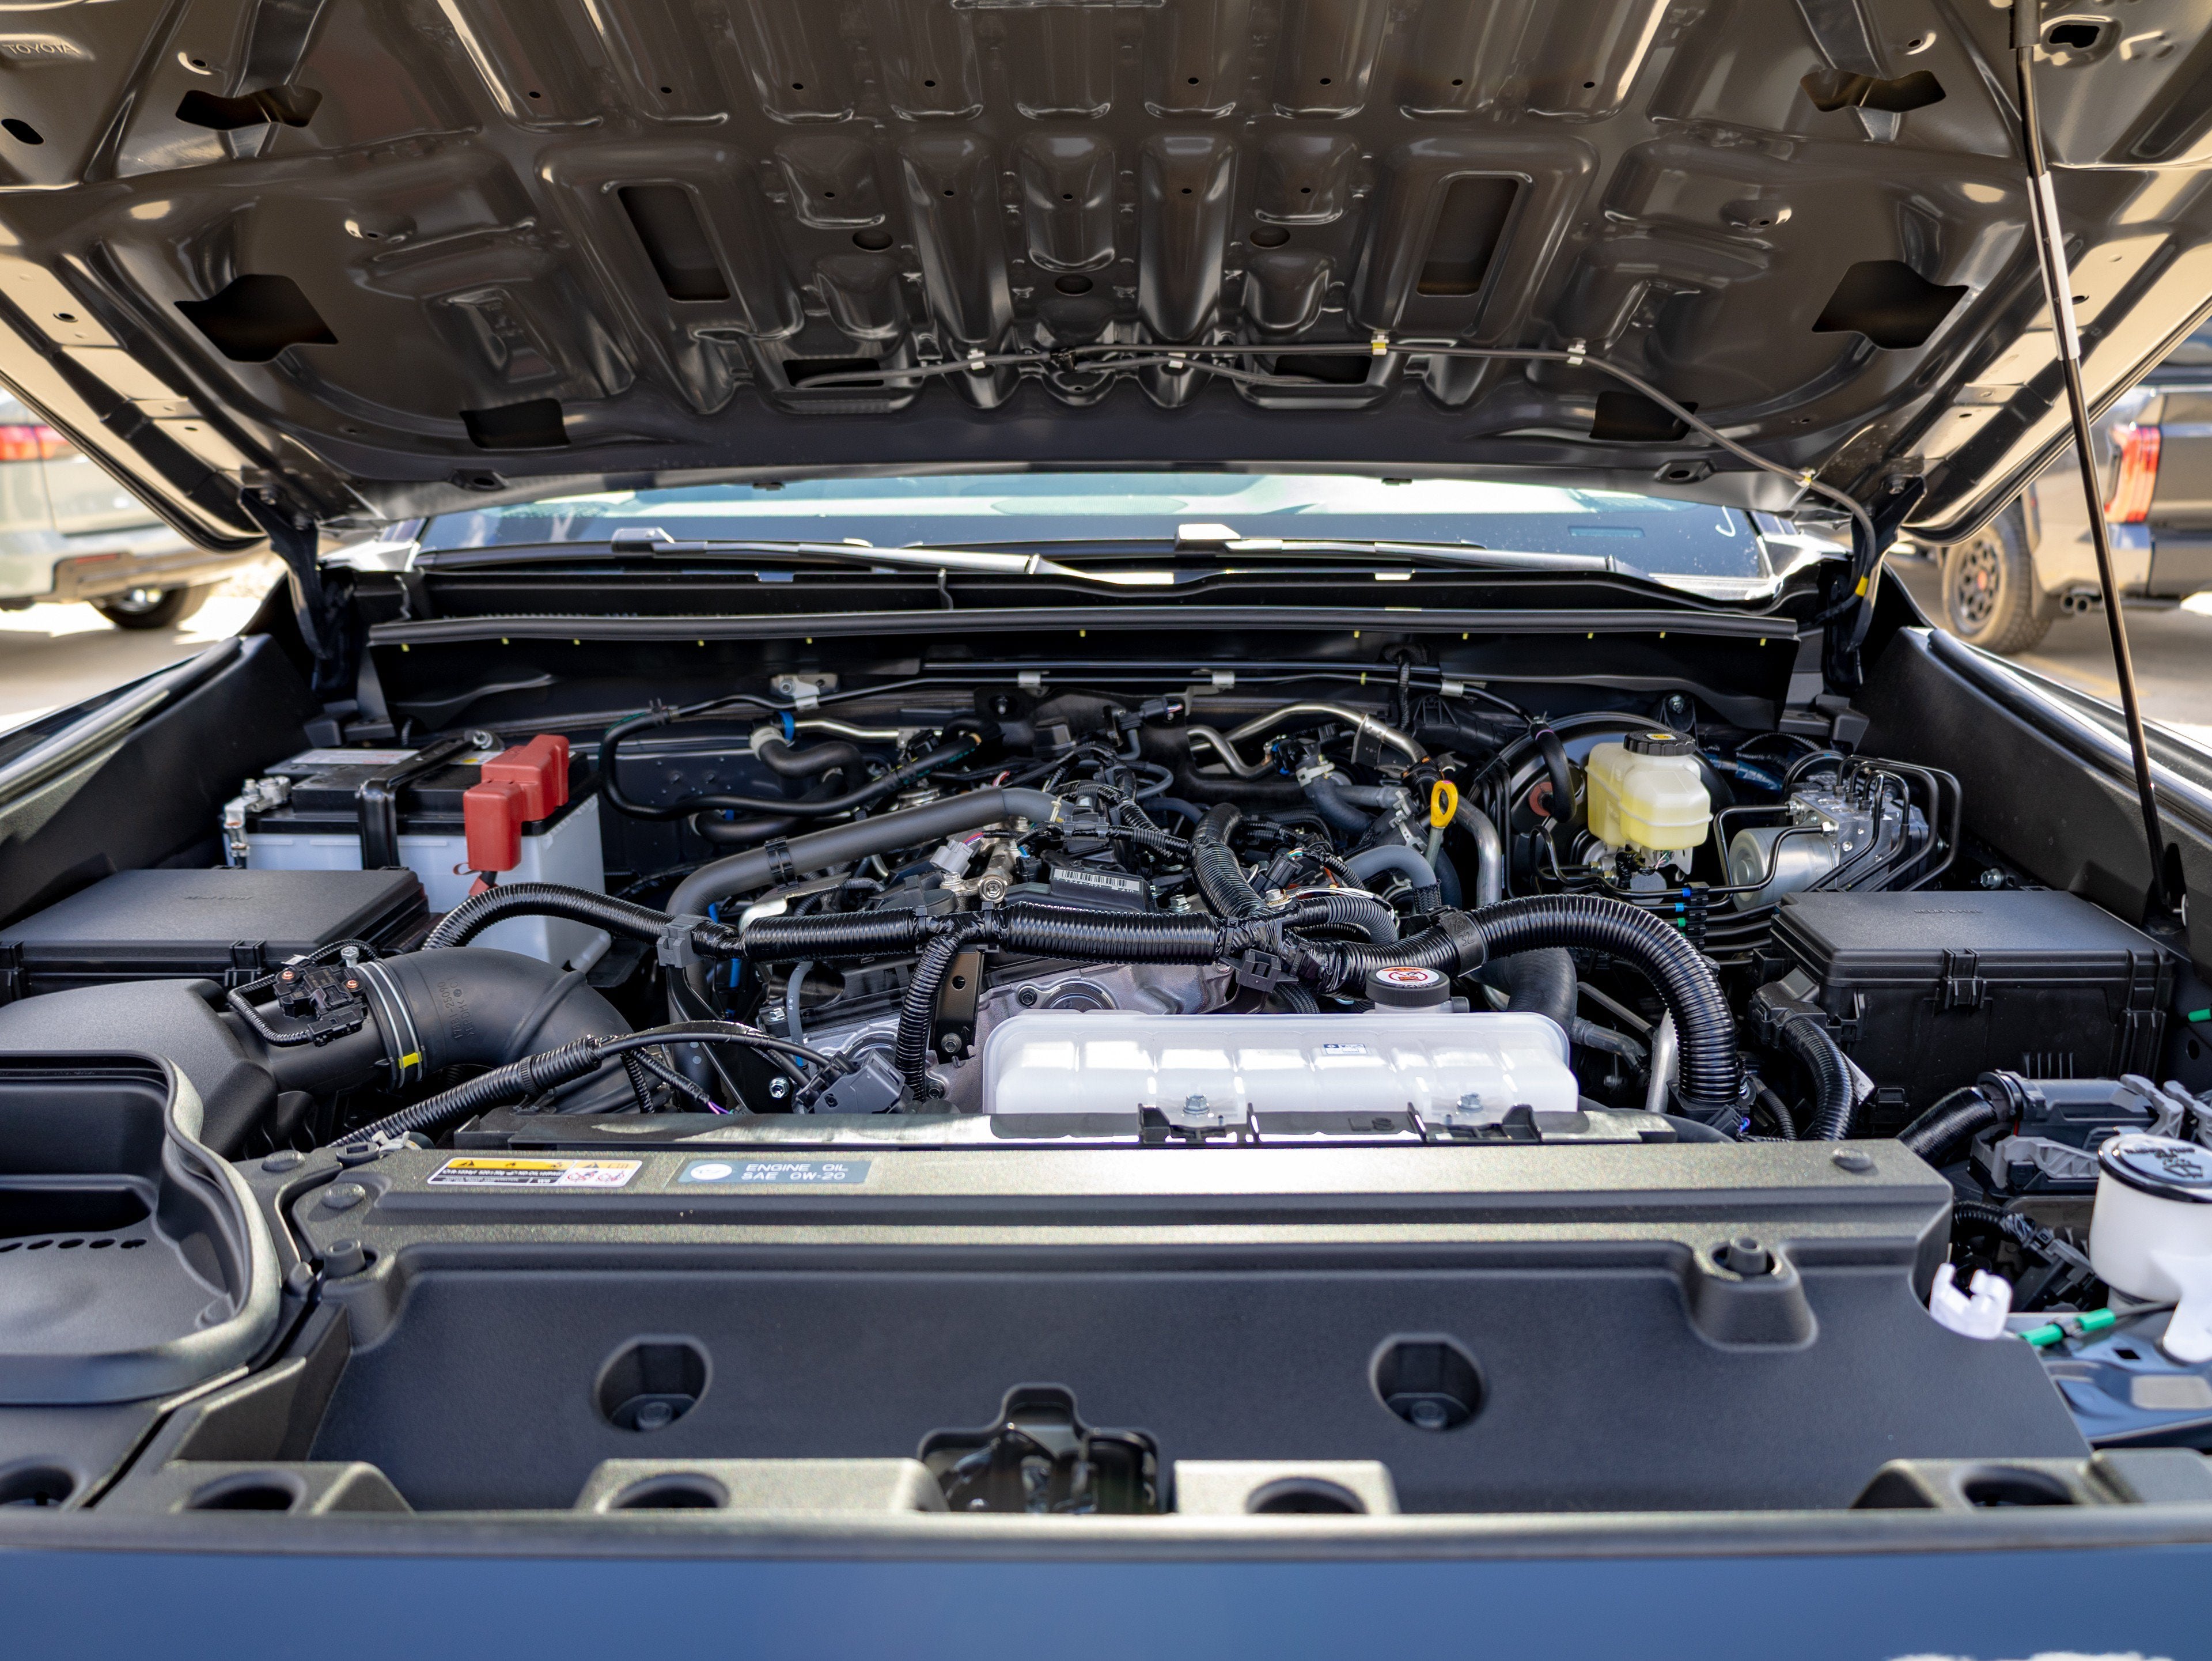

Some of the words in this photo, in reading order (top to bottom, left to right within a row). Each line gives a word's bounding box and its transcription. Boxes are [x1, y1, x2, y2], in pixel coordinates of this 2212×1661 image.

[2, 43, 81, 56] TOYOTA
[1457, 930, 1475, 947] 32
[745, 1164, 811, 1172] ENGINE
[822, 1164, 849, 1172] OIL
[741, 1172, 779, 1180] SAE
[790, 1172, 846, 1180] 0W-20
